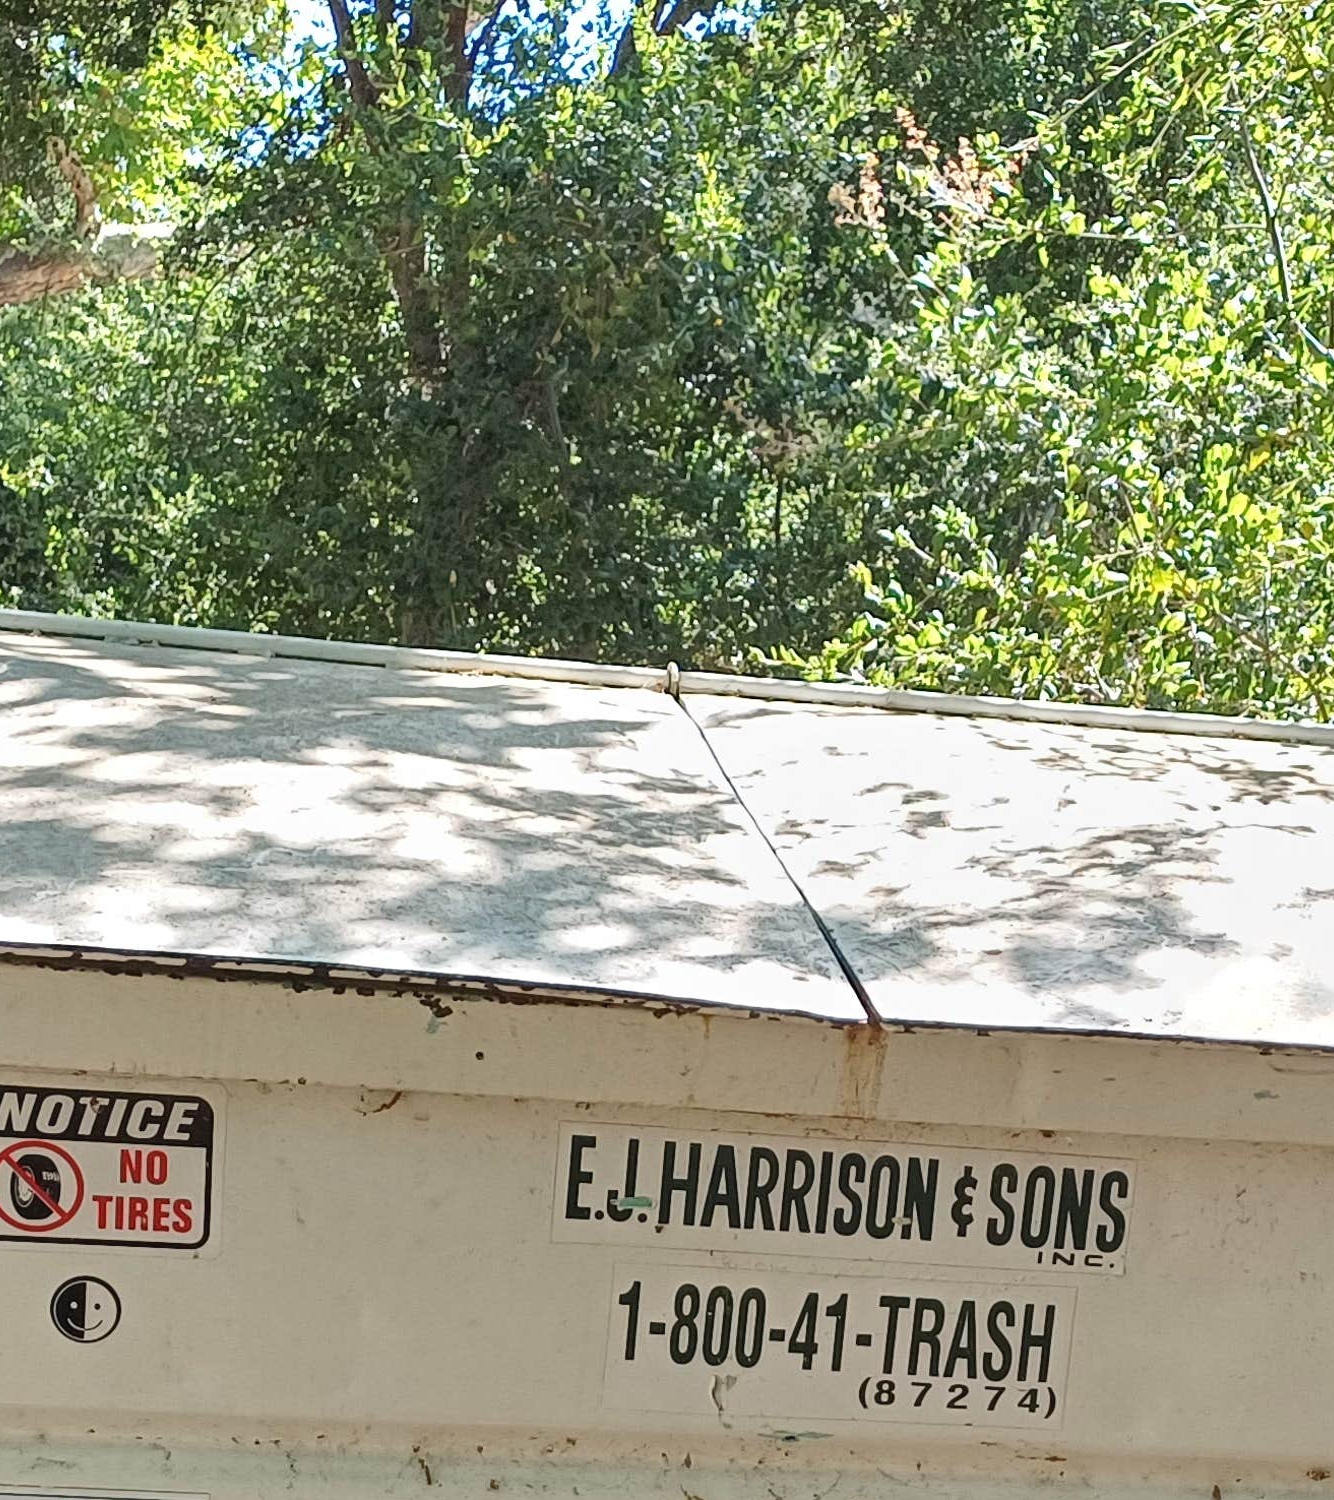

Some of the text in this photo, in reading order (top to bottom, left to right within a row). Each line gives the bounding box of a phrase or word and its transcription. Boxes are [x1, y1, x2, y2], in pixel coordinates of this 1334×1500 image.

[119, 1149, 167, 1185] NO
[565, 1135, 1128, 1253] E.J. HARRISON & SONS
[92, 1195, 192, 1233] TIRES
[1037, 1252, 1115, 1268] INC.
[618, 1281, 1055, 1383] 1-800-41-TRASH
